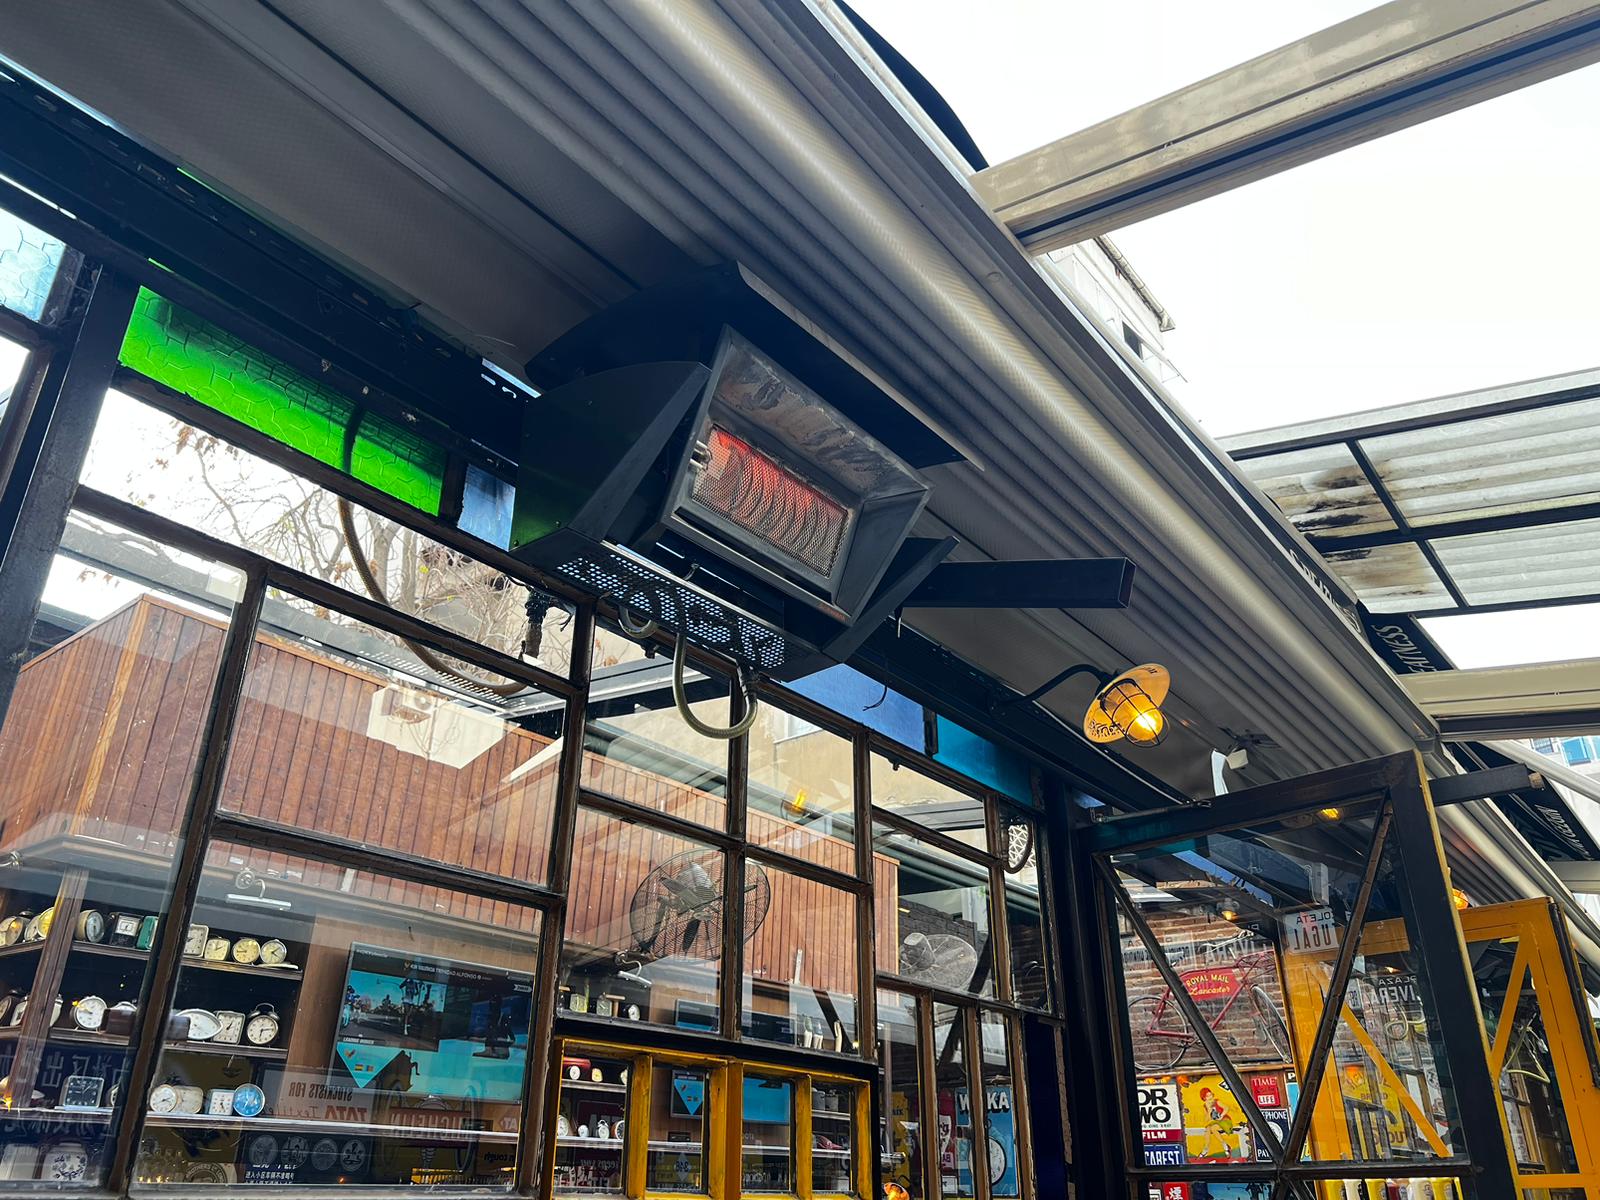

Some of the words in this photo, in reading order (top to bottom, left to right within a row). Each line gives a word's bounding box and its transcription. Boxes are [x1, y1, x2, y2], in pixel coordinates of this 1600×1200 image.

[1185, 974, 1208, 987] ROYAL
[1210, 973, 1230, 983] MAIL
[1253, 1077, 1276, 1087] TIME
[1258, 1096, 1274, 1104] LIFE
[1142, 1131, 1167, 1140] FILM
